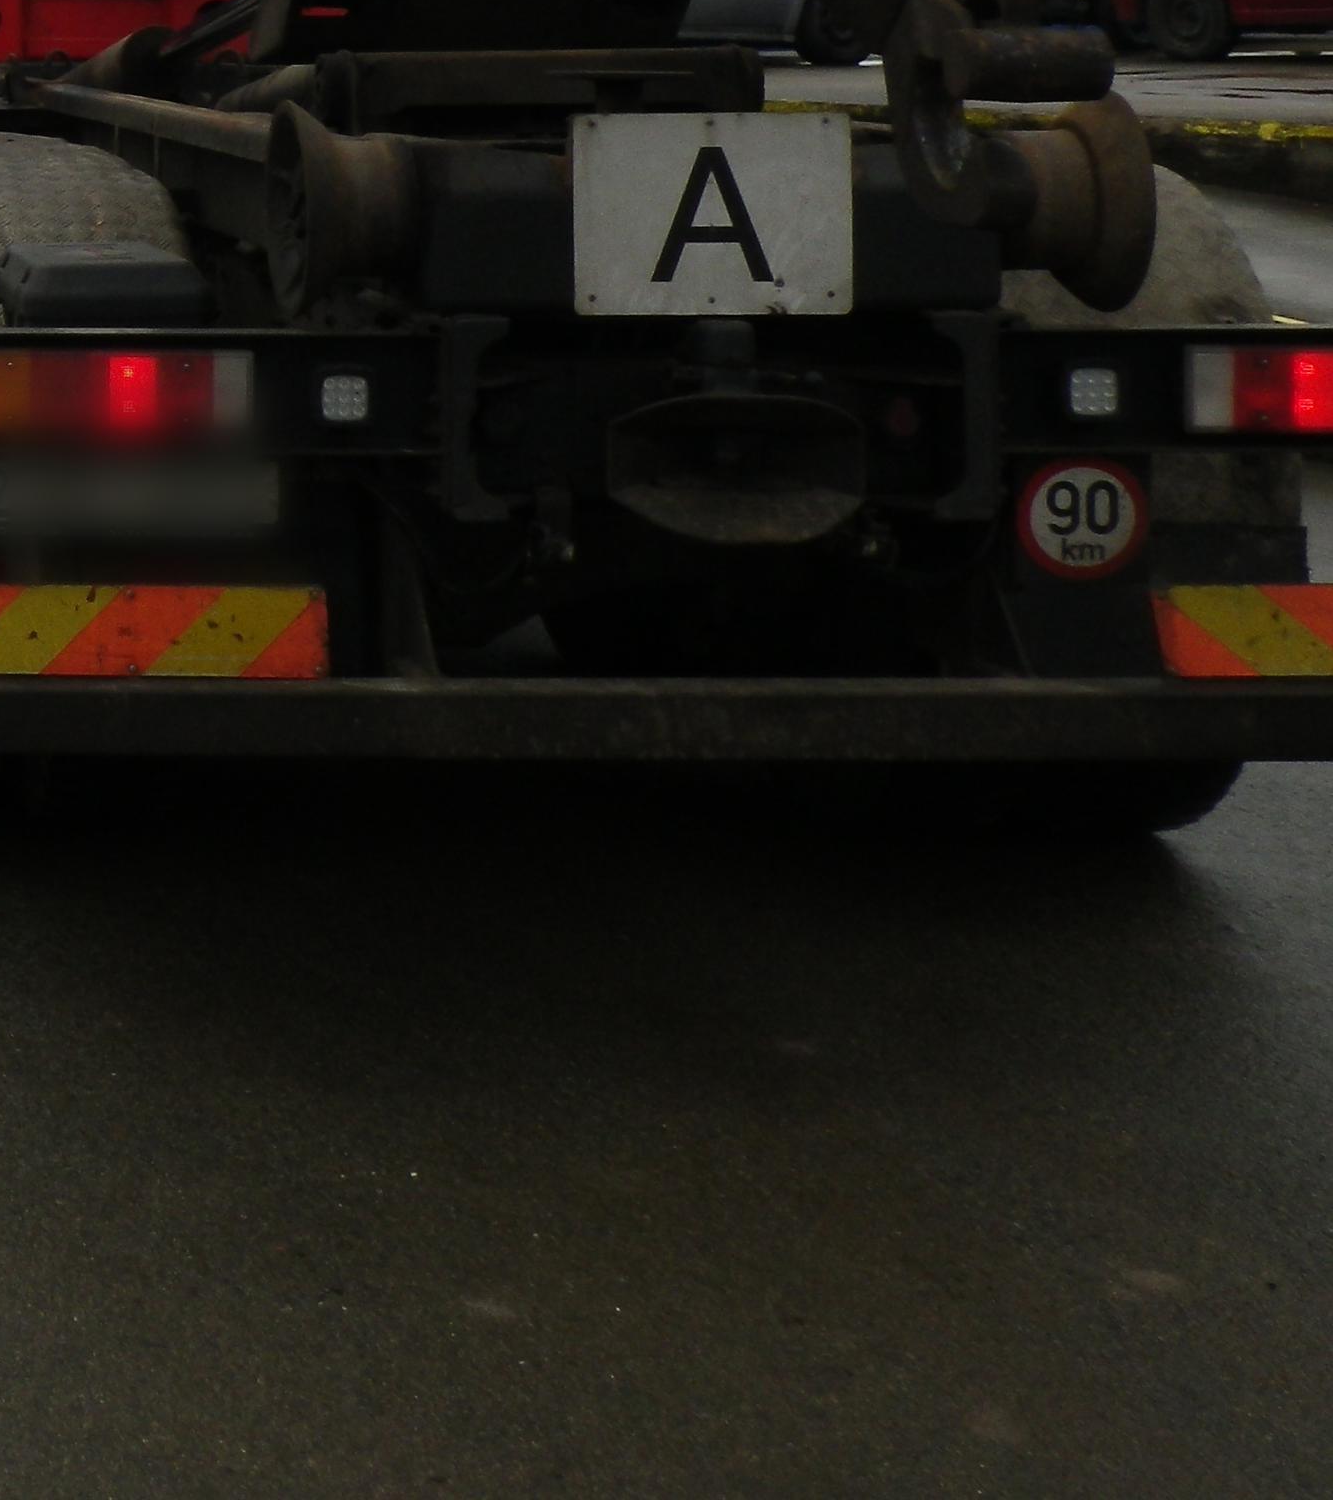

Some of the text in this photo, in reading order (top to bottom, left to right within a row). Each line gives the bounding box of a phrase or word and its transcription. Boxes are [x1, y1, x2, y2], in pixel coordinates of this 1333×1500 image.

[650, 145, 774, 283] A
[1046, 480, 1119, 536] 90
[1061, 538, 1105, 562] km
